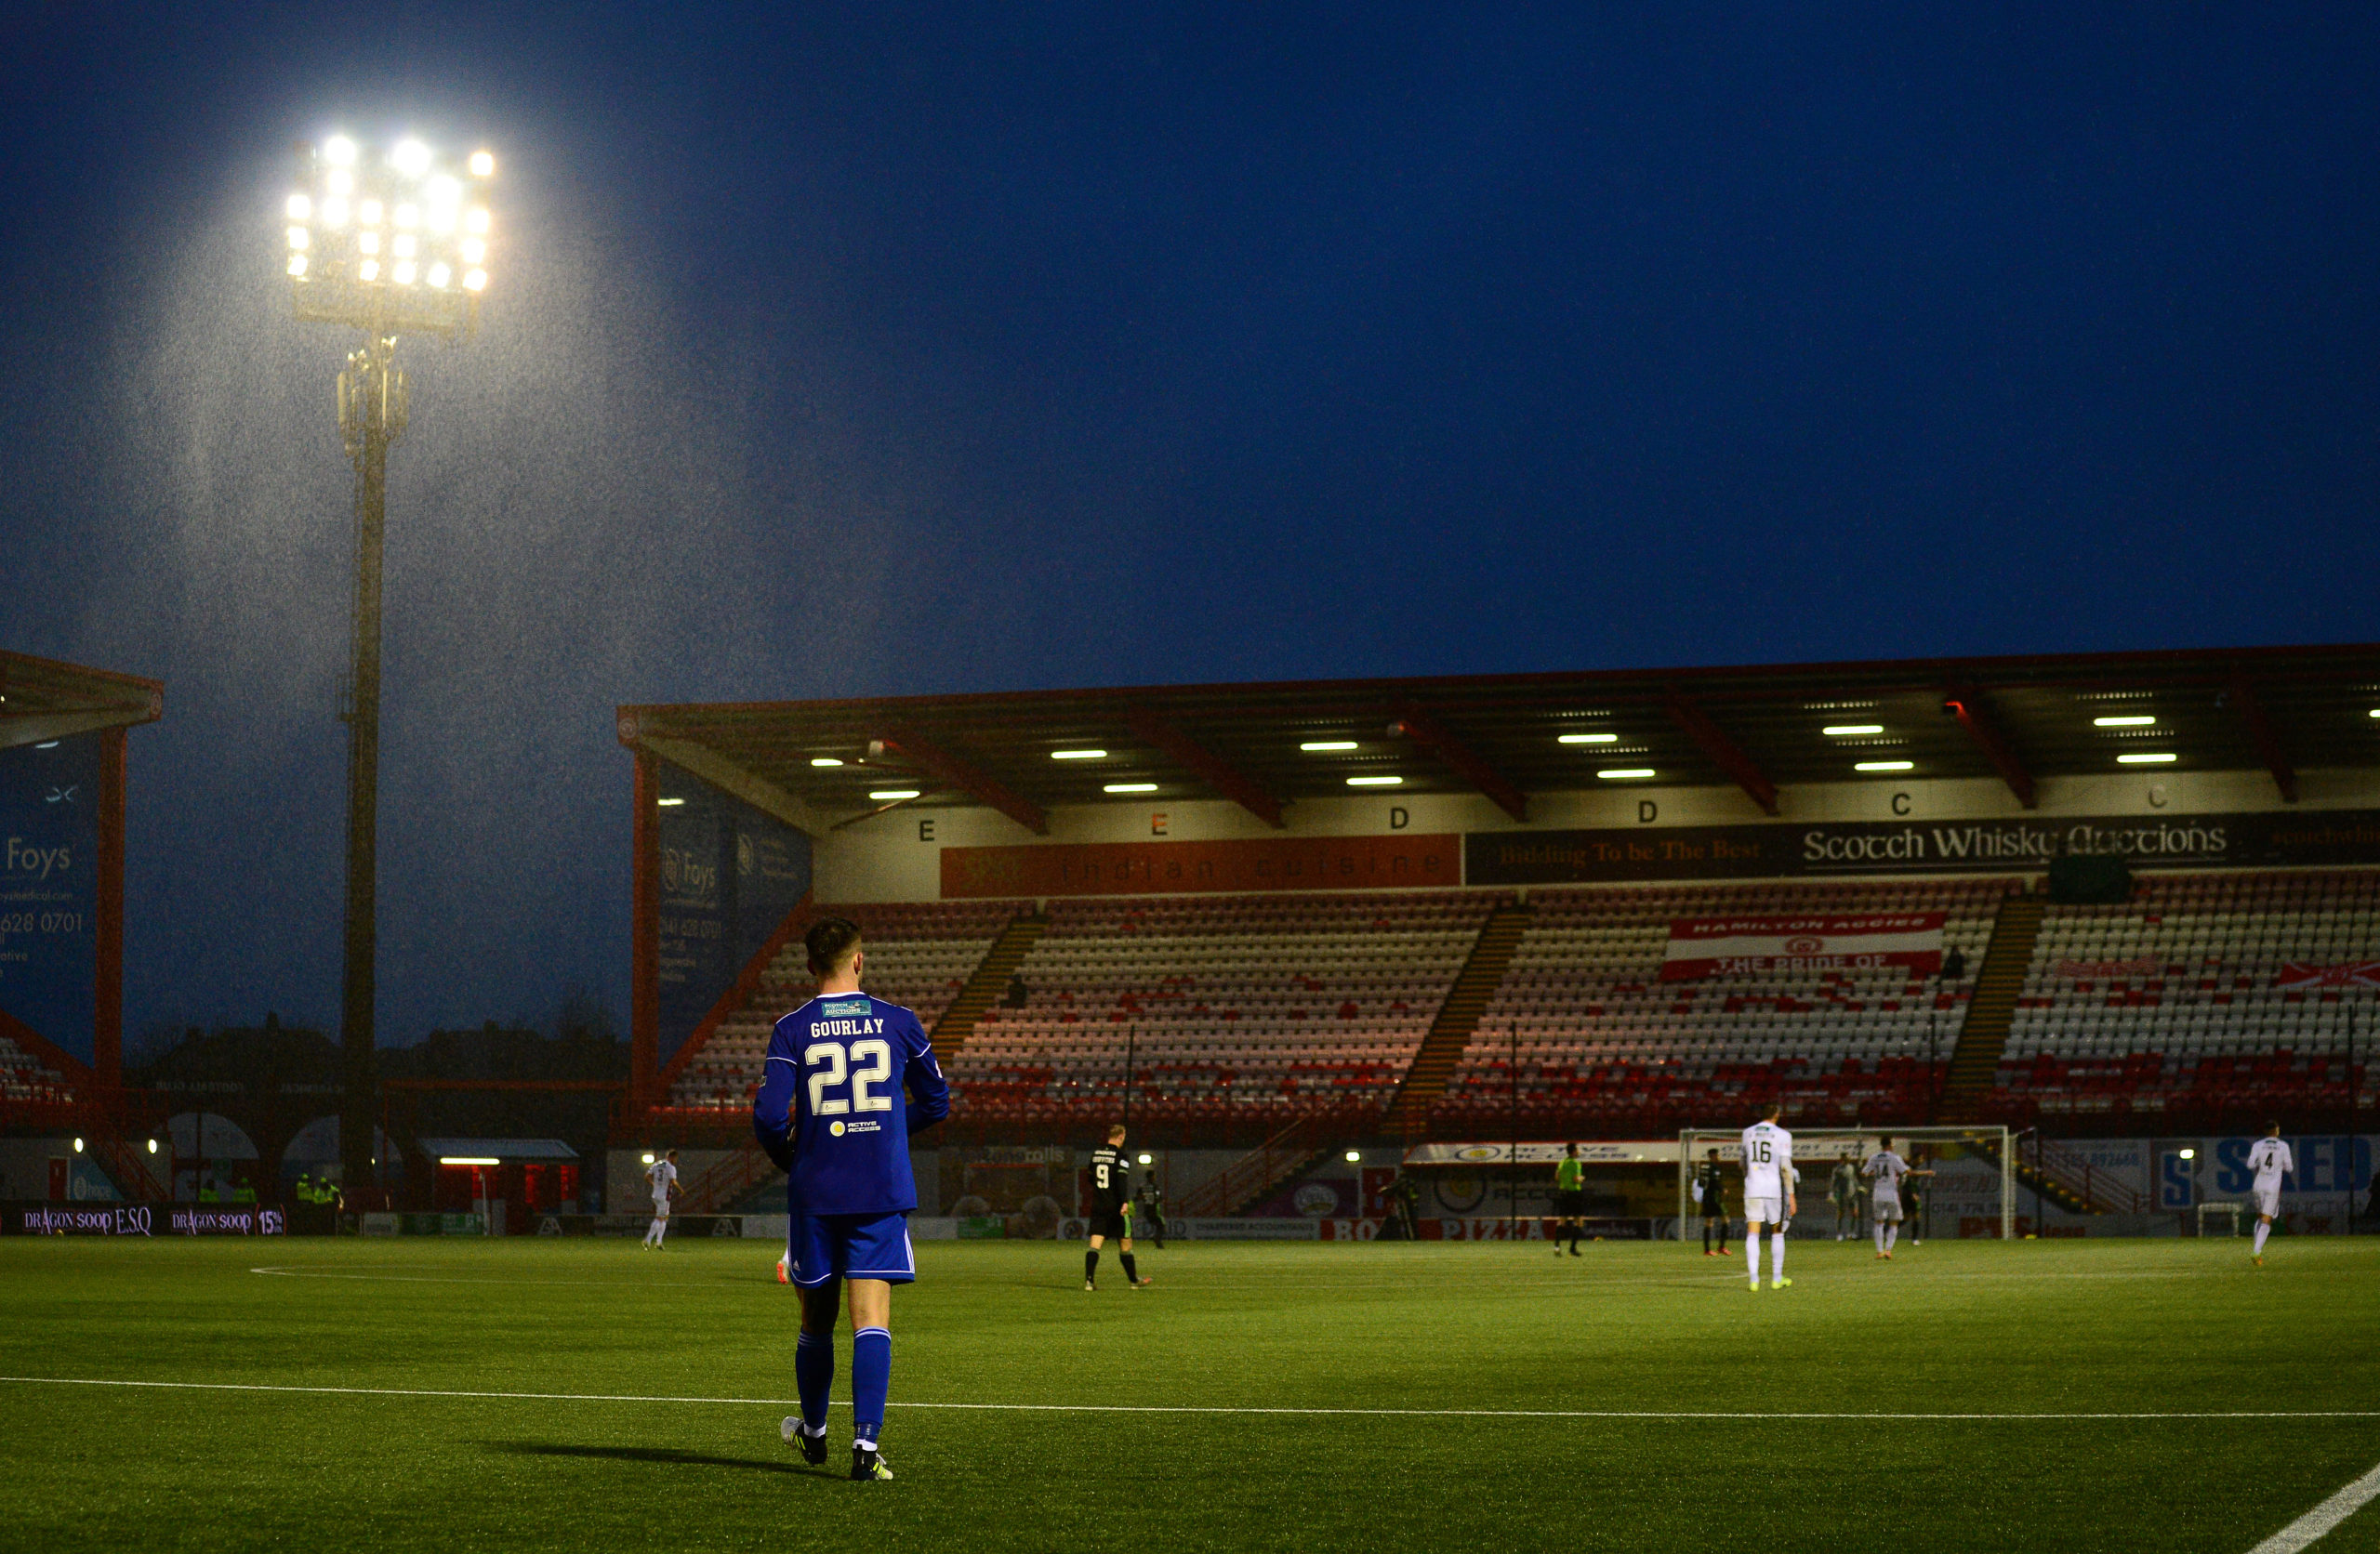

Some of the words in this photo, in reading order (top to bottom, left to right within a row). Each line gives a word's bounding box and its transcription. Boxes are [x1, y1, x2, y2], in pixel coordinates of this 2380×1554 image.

[1639, 801, 1658, 823] D
[1892, 793, 1911, 816] C
[1151, 813, 1169, 836] E
[1390, 807, 1409, 830] D
[919, 820, 935, 842] E
[1803, 828, 1924, 861] Scotch
[1932, 825, 2060, 863] Whisky
[2068, 822, 2228, 857] Auctions
[7, 836, 71, 880] Foys
[1500, 845, 1586, 868] Bidding
[1592, 842, 1621, 863] To
[1628, 841, 1655, 862] be
[1659, 840, 1705, 861] The
[1712, 839, 1761, 859] Best
[0, 912, 34, 933] 628
[40, 912, 83, 933] 0701
[1692, 919, 1825, 934] HAMILTON
[1715, 957, 1765, 972] THE
[1774, 955, 1845, 971] PRIDE
[1854, 955, 1887, 969] OF
[810, 1018, 884, 1039] GOURLAY
[804, 1038, 892, 1115] 22
[1751, 1139, 1772, 1164] 16
[2264, 1151, 2274, 1170] 4
[1095, 1163, 1111, 1190] 9
[2216, 1137, 2372, 1193] SED
[24, 1207, 74, 1235] DRAGON
[172, 1208, 217, 1235] DRAGON
[1439, 1218, 1546, 1241] PIZZA
